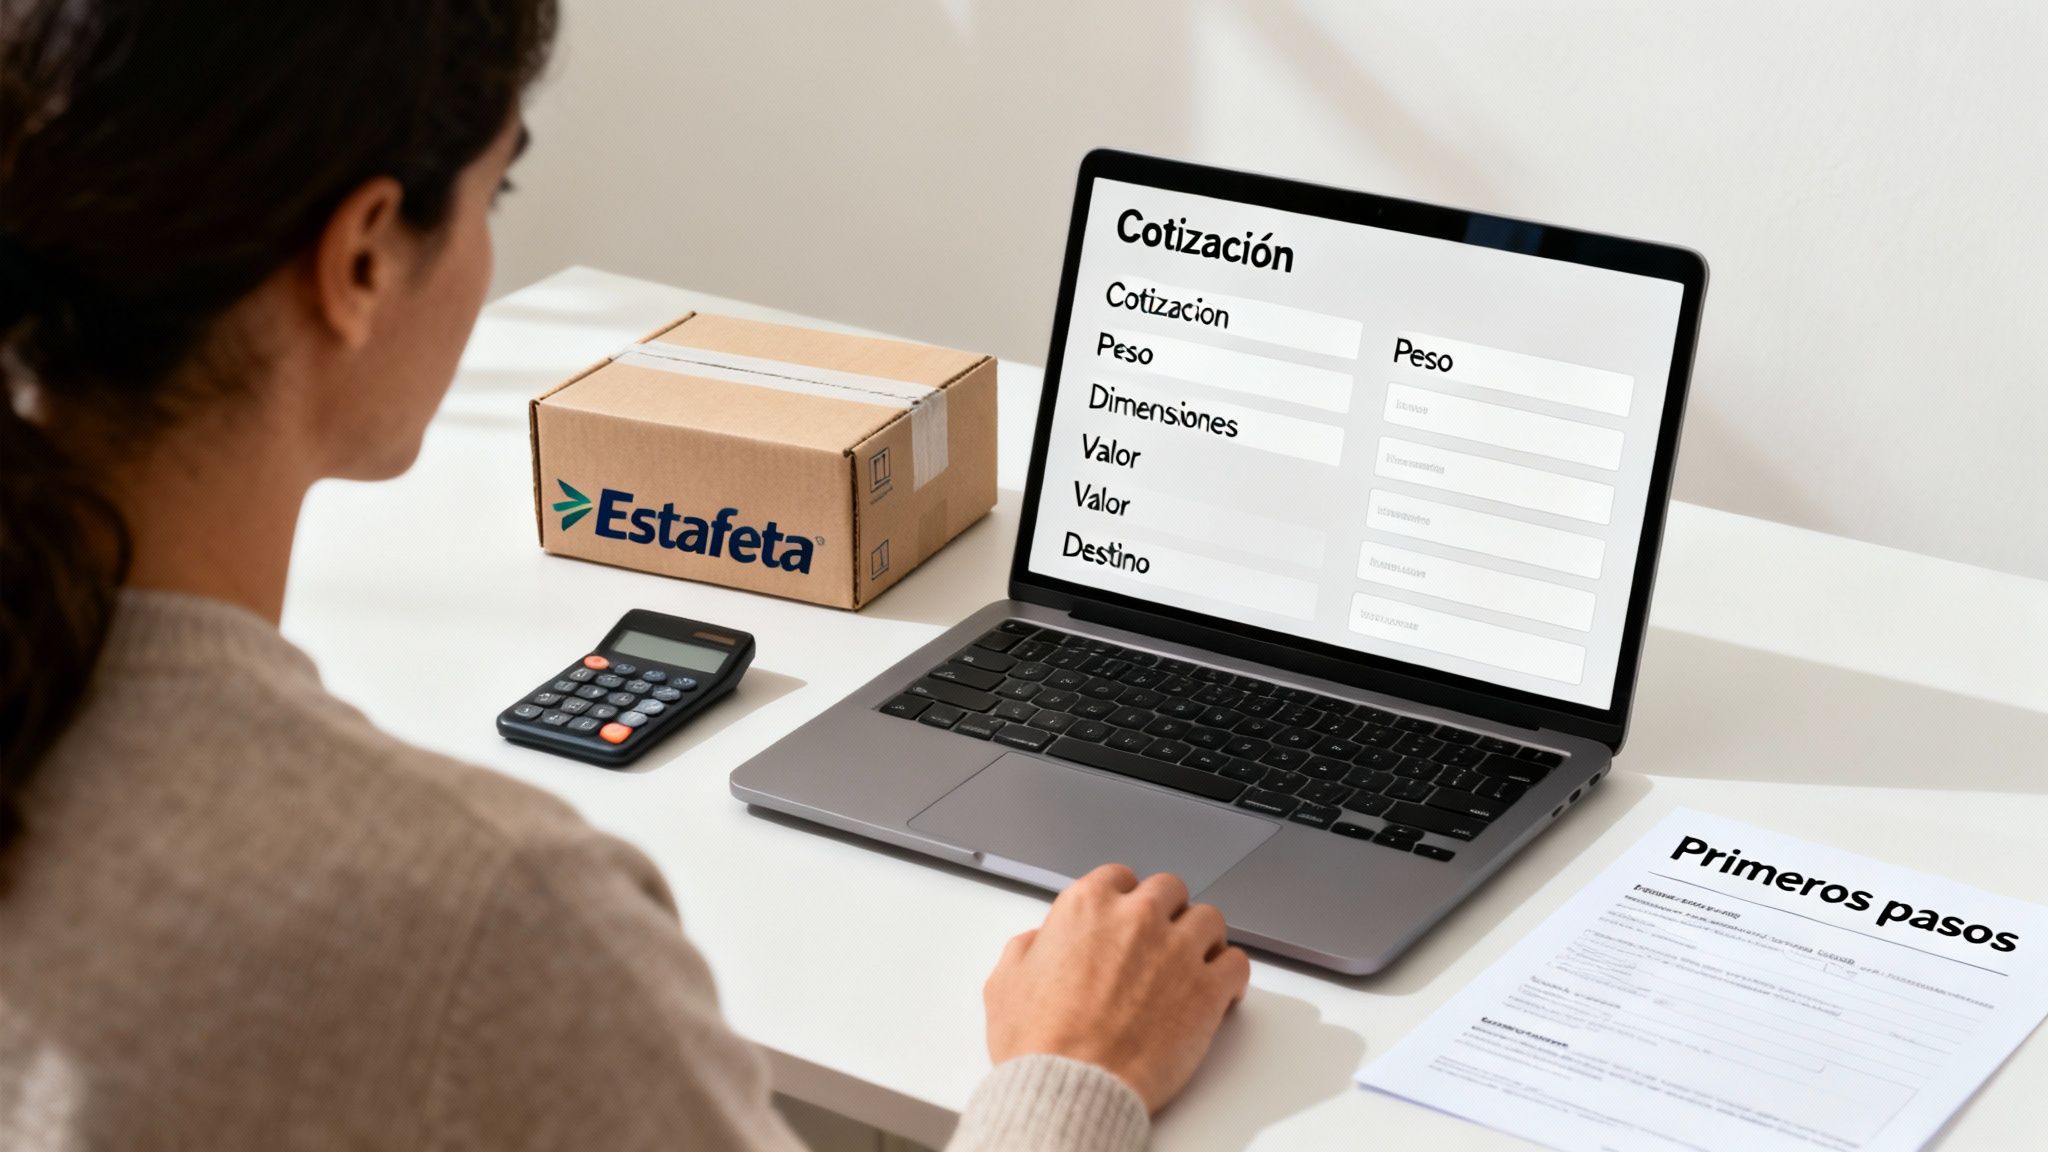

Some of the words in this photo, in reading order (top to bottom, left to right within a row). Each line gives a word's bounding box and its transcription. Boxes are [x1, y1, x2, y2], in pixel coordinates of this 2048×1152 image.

[1117, 208, 1295, 273] Cotización
[1105, 281, 1230, 329] Cotizacion
[1096, 331, 1154, 366] Peso
[1393, 337, 1455, 374] Peso
[1088, 383, 1239, 438] Dimensiones
[1082, 433, 1142, 470] Valor
[1074, 480, 1132, 517] Valor
[594, 488, 815, 575] Estafeta
[1062, 531, 1151, 575] Destino
[1670, 835, 1874, 912] Primeros
[1875, 900, 2020, 953] pasos
